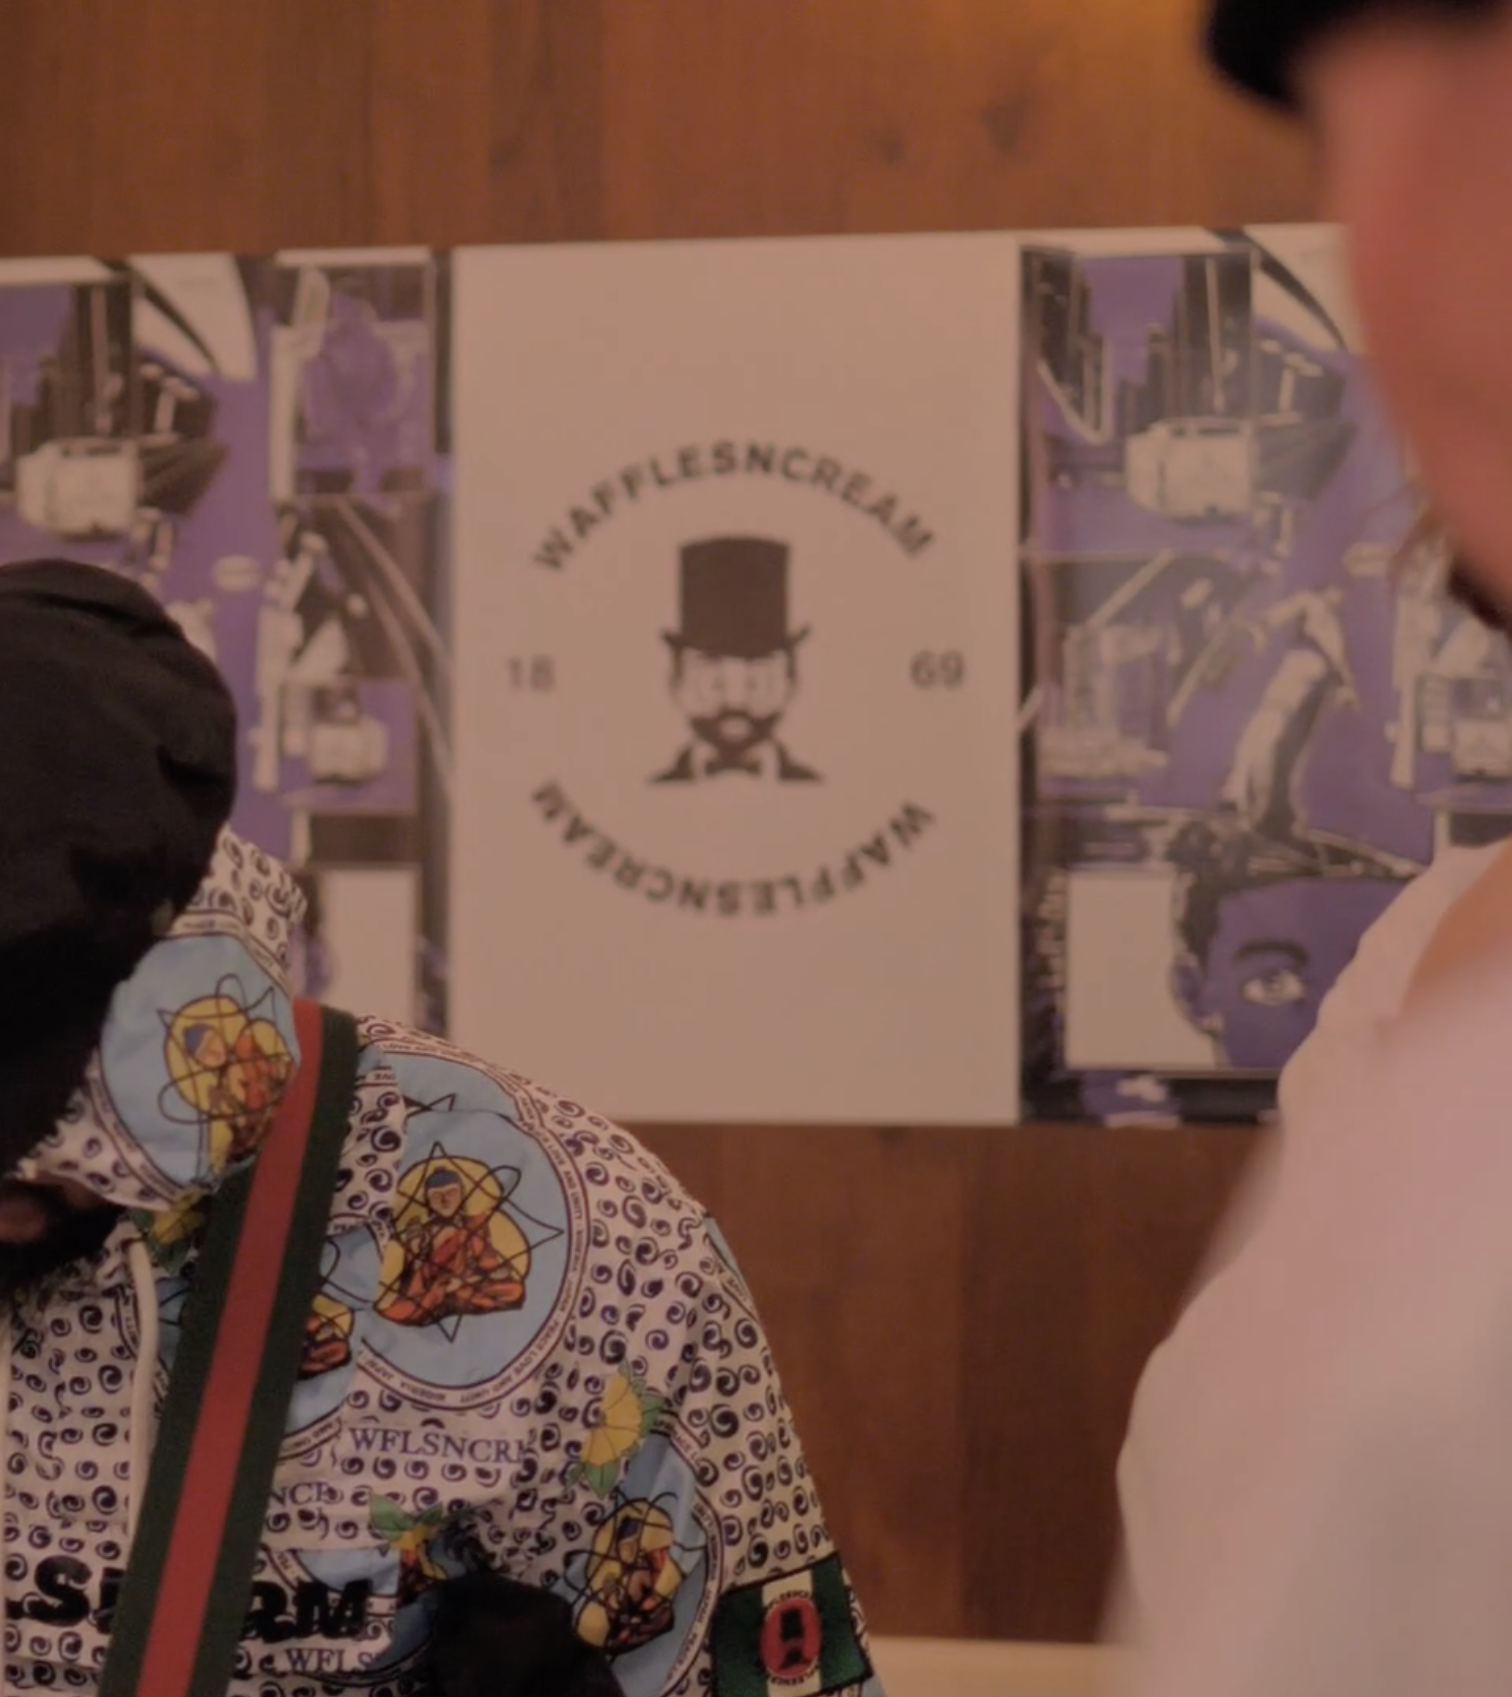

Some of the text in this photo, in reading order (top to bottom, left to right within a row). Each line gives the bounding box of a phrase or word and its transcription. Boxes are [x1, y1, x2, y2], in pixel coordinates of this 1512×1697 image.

[534, 441, 935, 574] WAFFLESNCREAM
[507, 655, 554, 691] 18
[910, 651, 965, 689] 69
[531, 779, 935, 918] WAFFLESNCREAM
